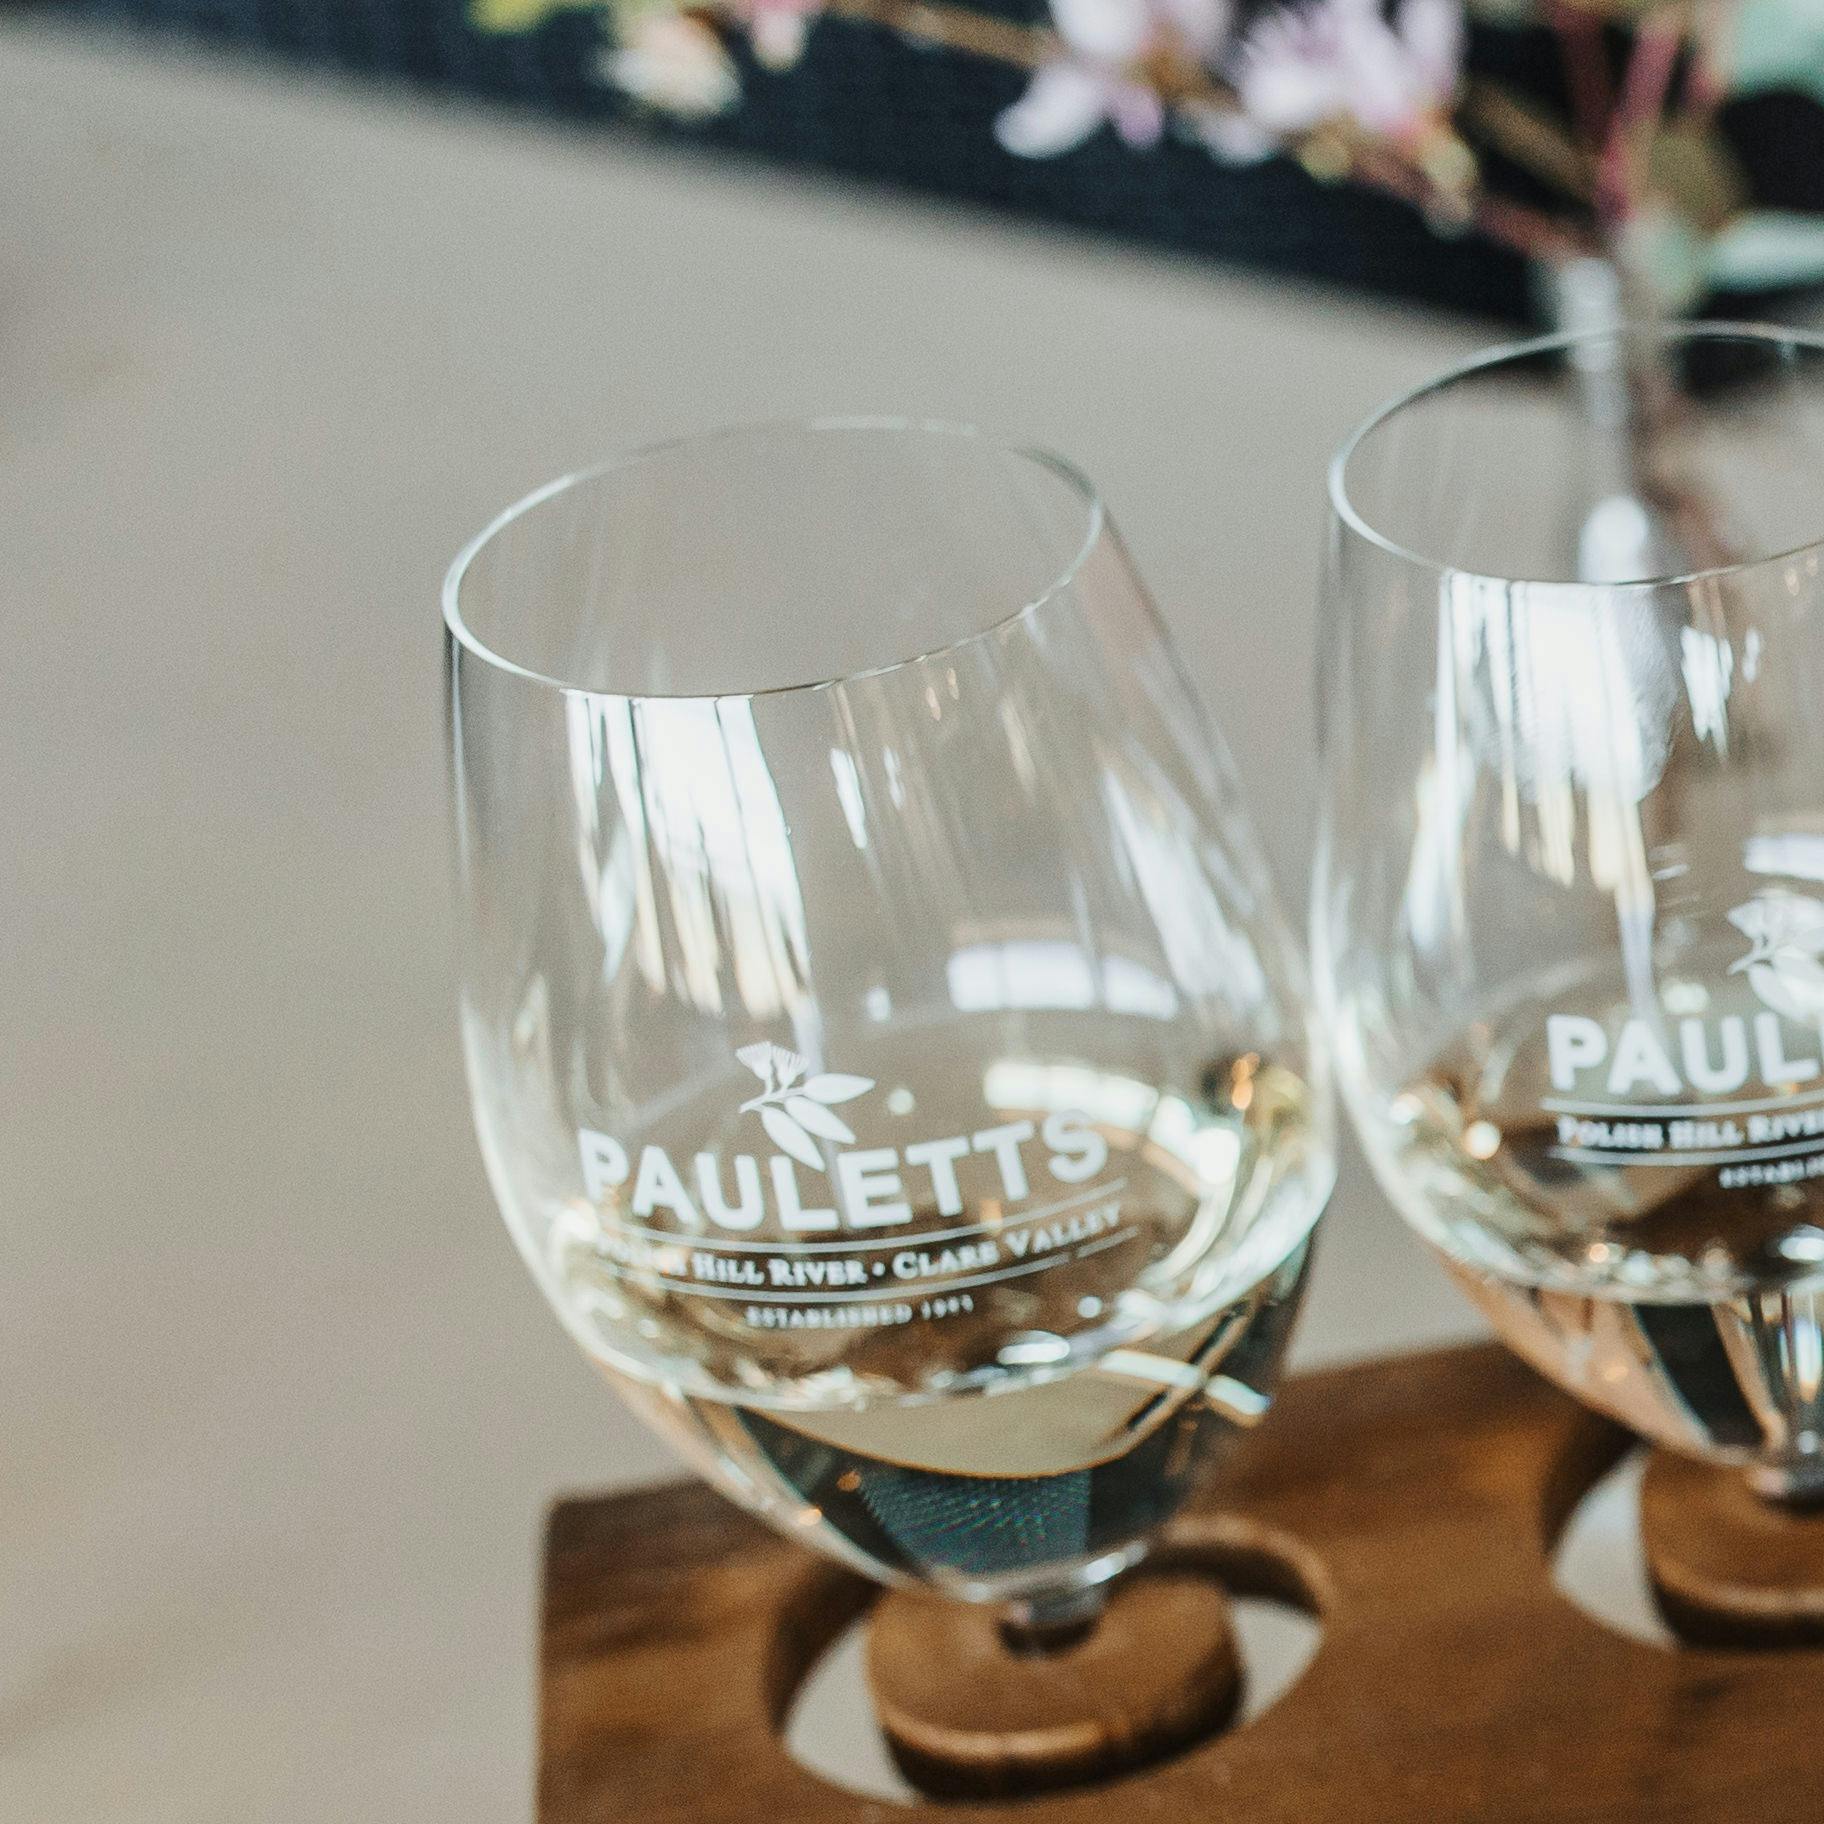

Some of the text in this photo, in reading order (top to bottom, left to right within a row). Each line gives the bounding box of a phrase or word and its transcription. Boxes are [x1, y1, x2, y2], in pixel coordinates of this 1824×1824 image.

[578, 1110, 1109, 1231] PAULETTS
[691, 1251, 765, 1286] HILL
[767, 1257, 869, 1287] RIVER
[891, 1240, 999, 1280] CLARE
[1003, 1201, 1122, 1258] VALLEY
